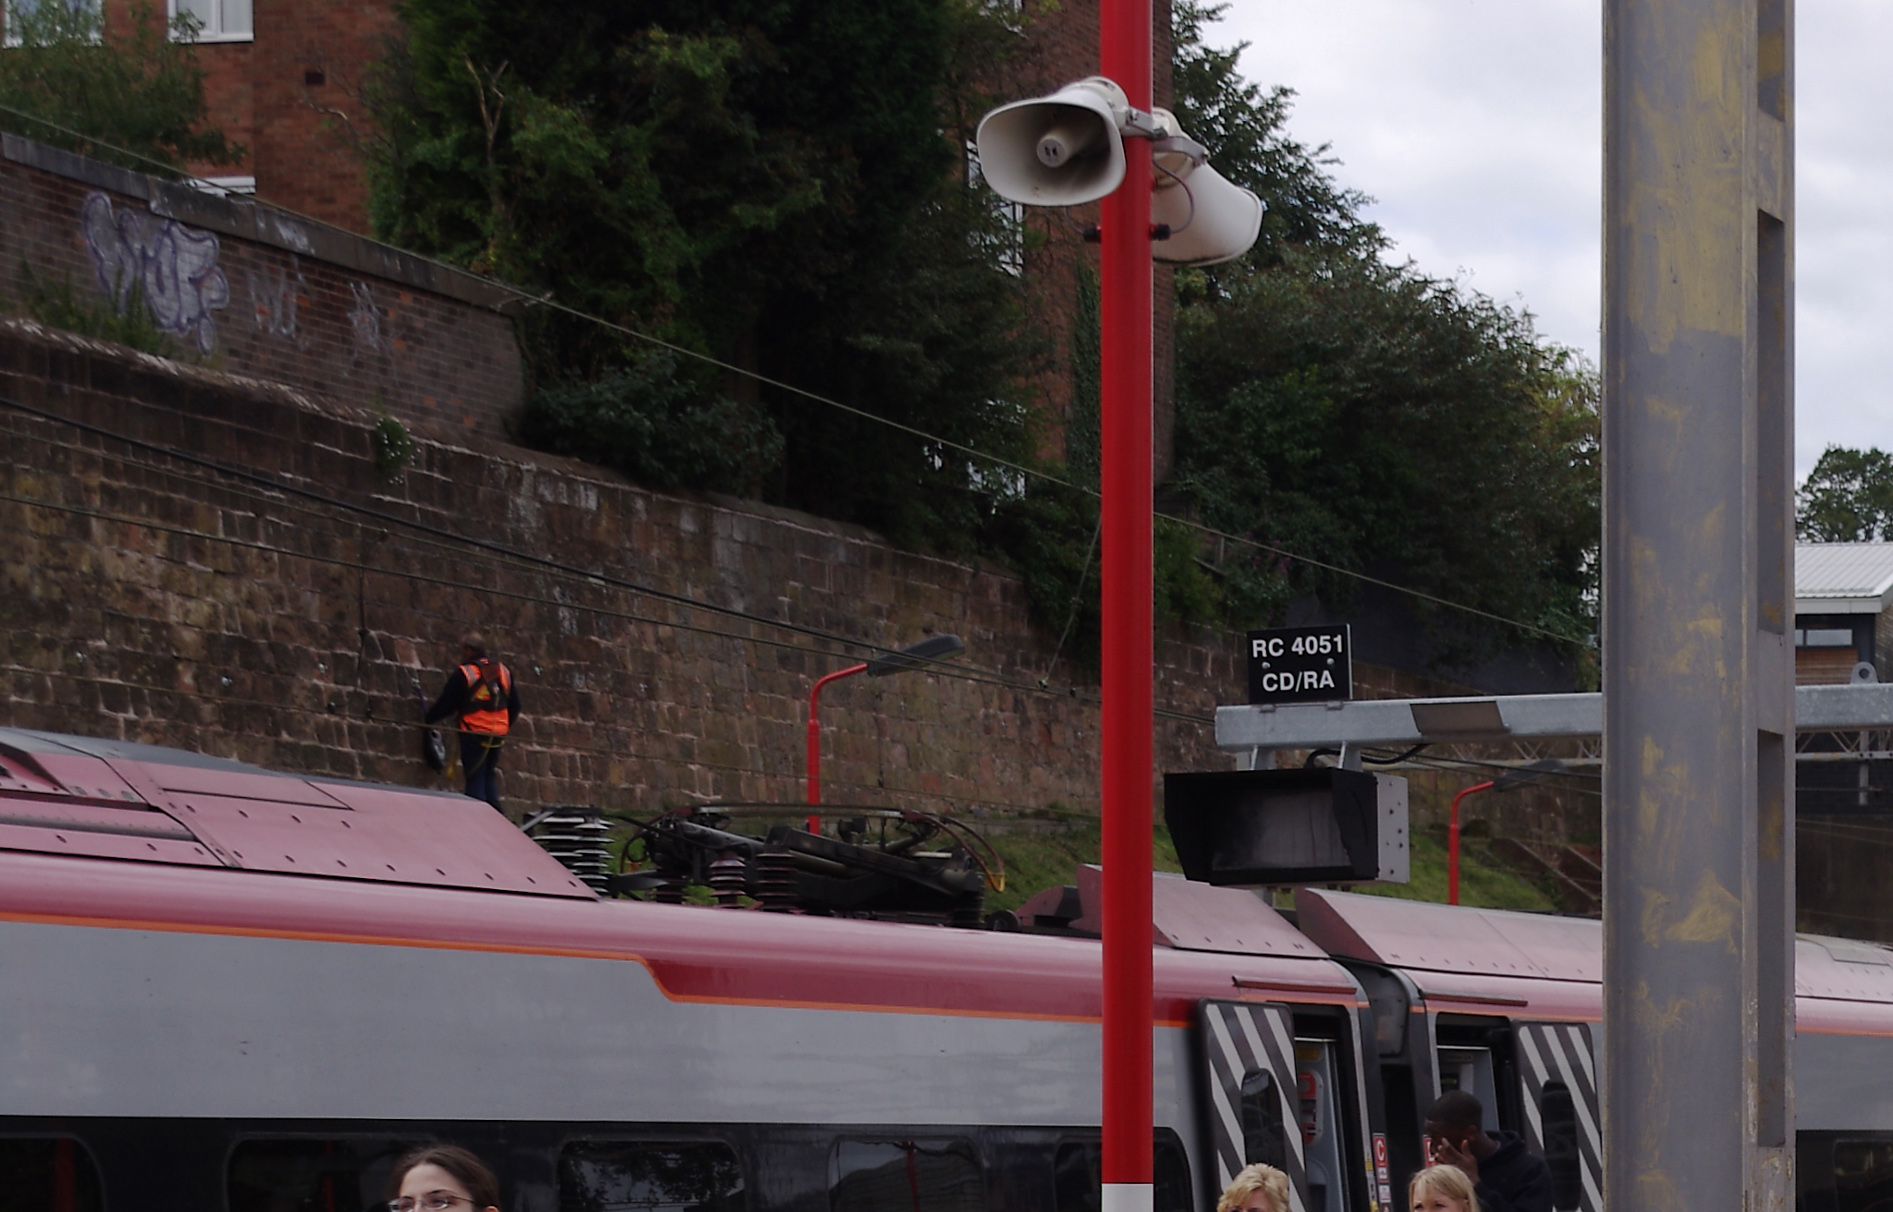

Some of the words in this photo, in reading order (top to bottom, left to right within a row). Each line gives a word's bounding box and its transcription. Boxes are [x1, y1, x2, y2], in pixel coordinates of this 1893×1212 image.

[1252, 638, 1285, 658] RC
[1291, 633, 1343, 656] 4051
[1262, 669, 1336, 692] CD/RA
